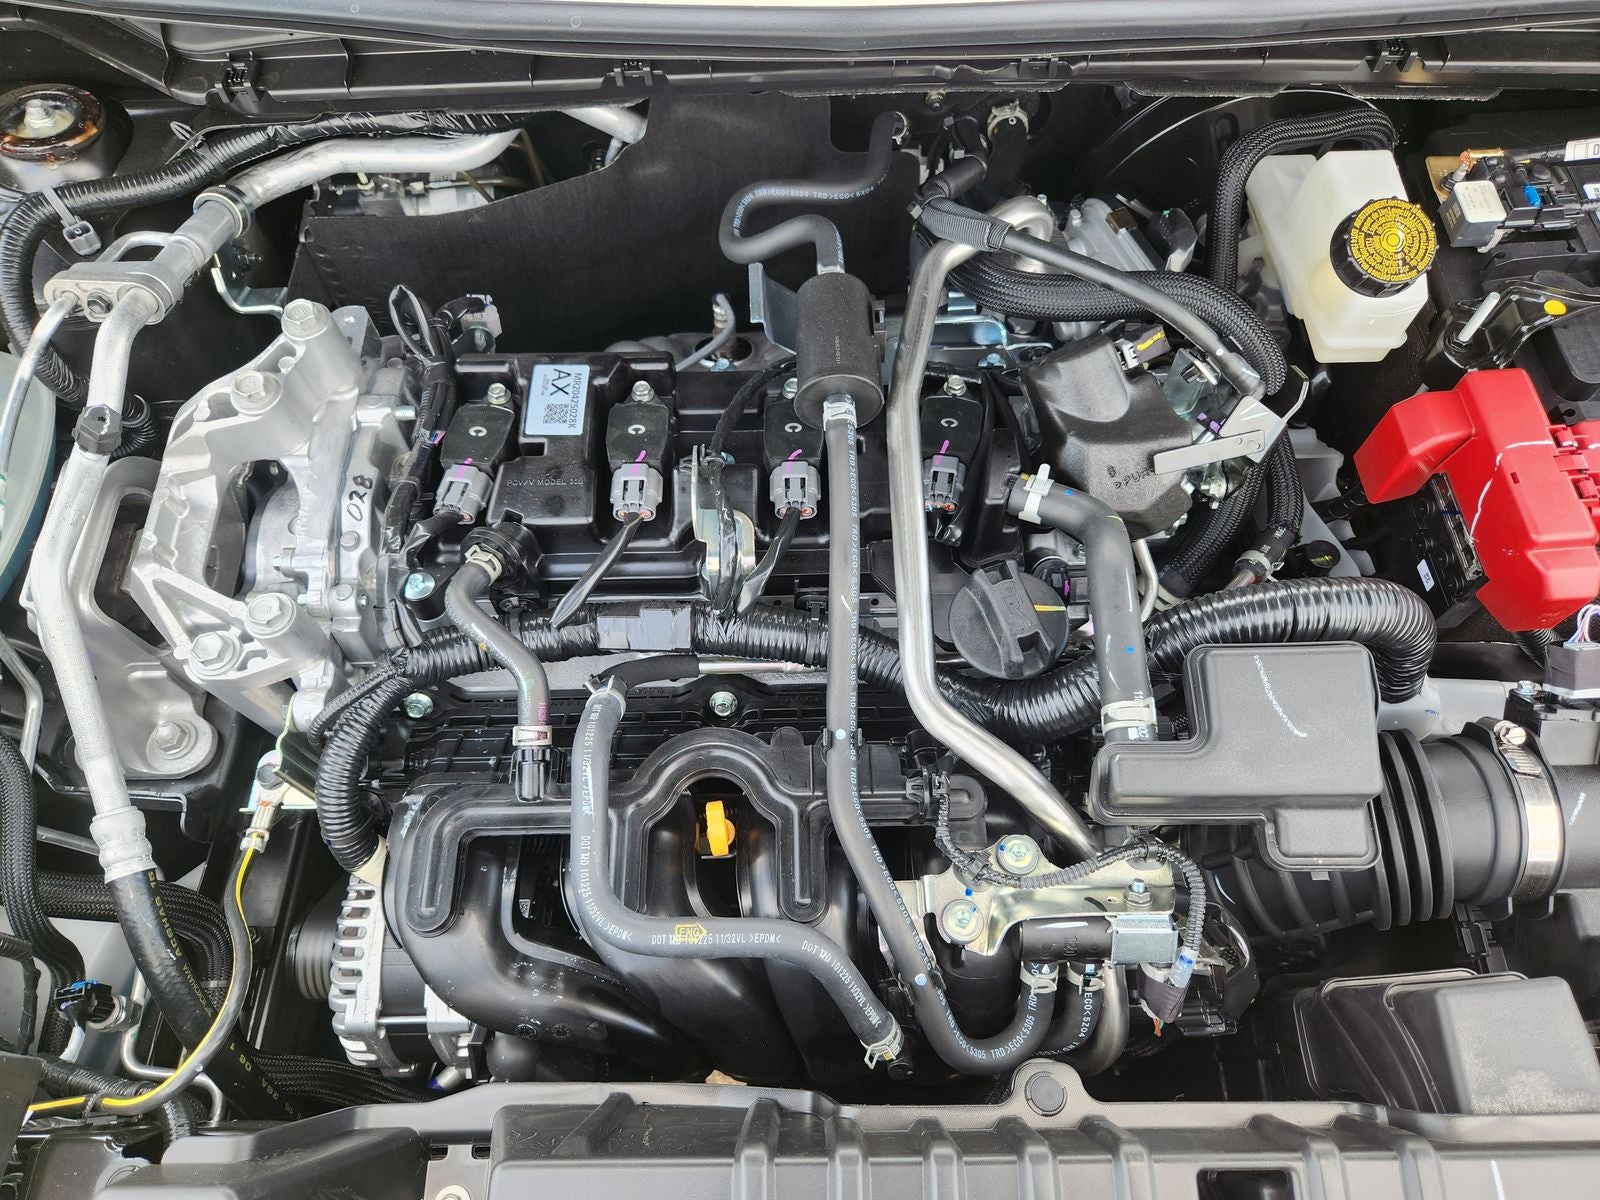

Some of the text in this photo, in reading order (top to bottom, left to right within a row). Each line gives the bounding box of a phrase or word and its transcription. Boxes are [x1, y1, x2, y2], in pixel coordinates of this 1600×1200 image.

[549, 368, 572, 396] AX
[651, 934, 667, 945] DOT
[715, 933, 746, 944] 11/32VL
[748, 932, 782, 944] >EPDM<
[801, 940, 818, 954] DOT
